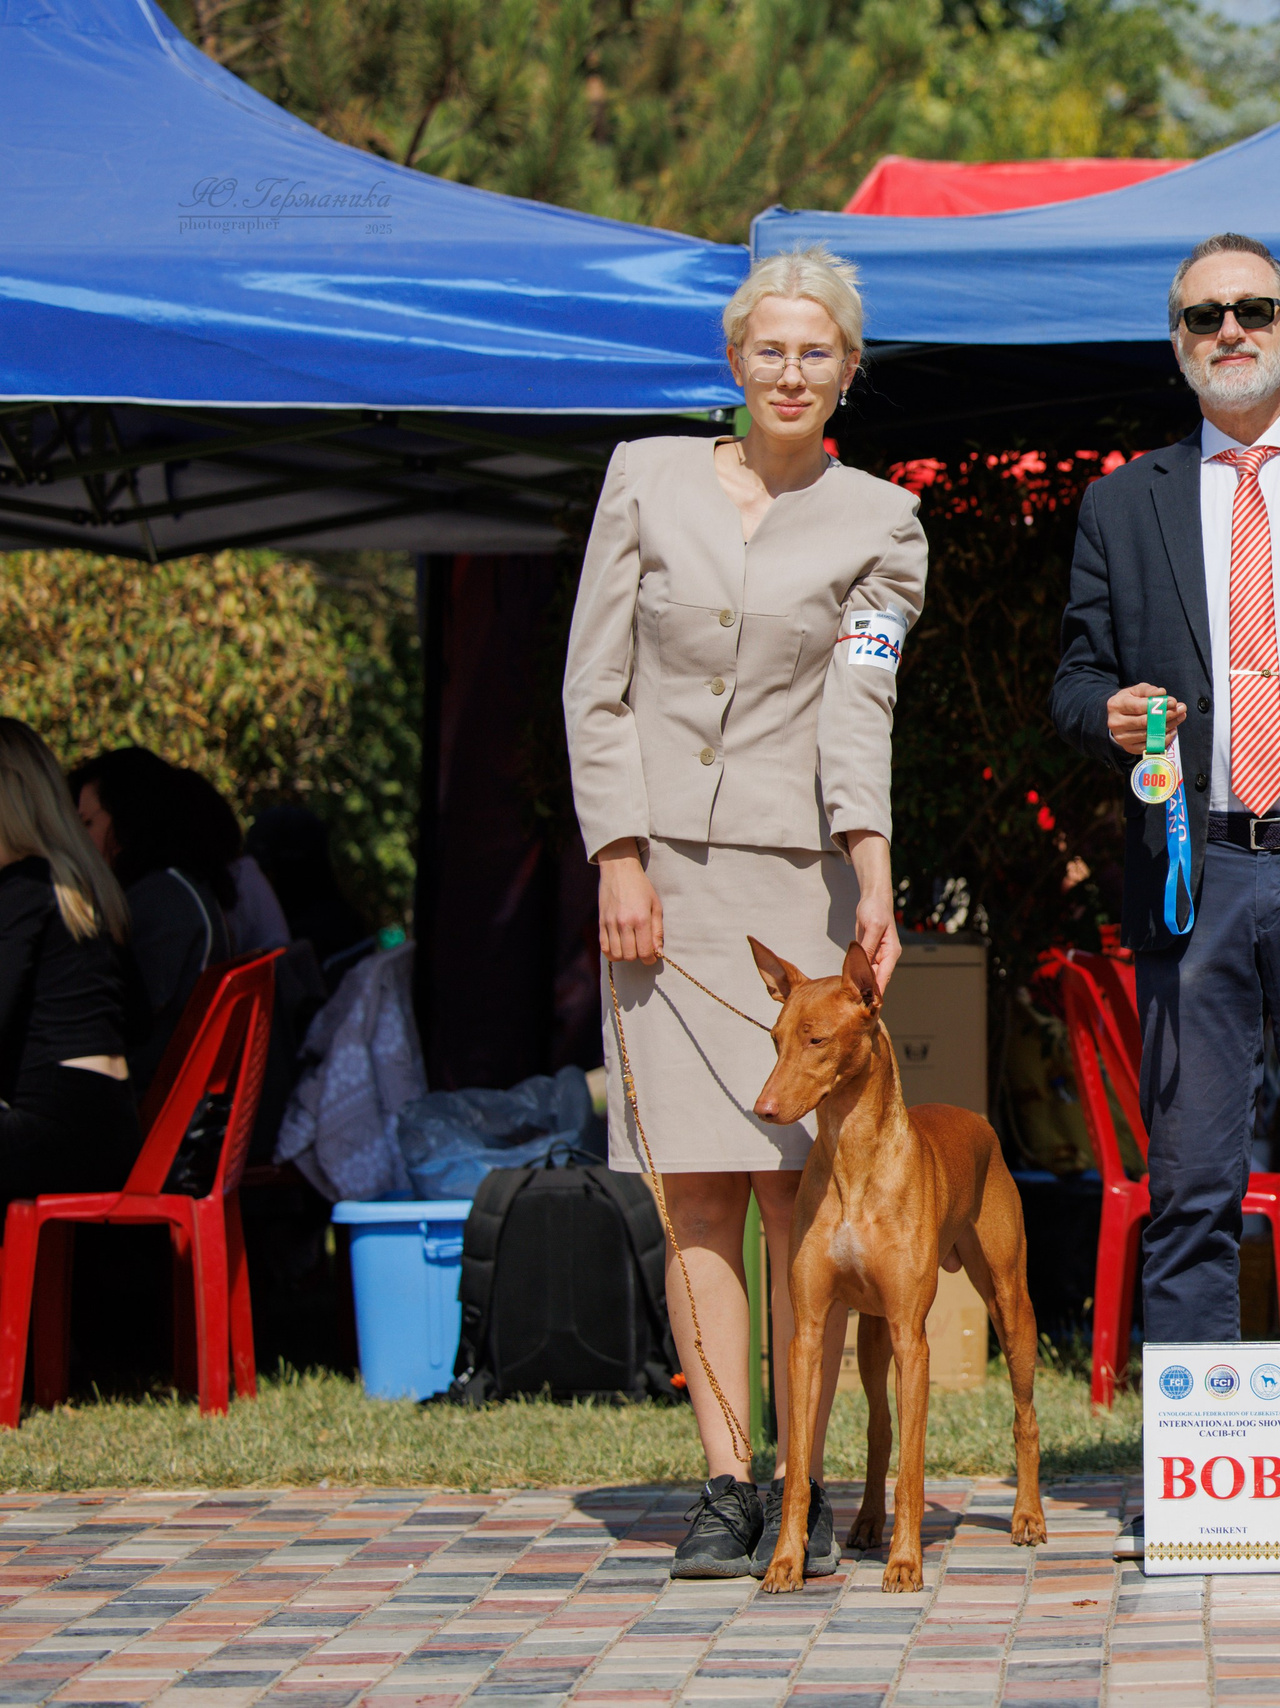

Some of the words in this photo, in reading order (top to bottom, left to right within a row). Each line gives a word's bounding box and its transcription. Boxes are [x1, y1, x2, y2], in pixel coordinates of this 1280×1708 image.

[855, 631, 900, 664] 224
[1143, 773, 1166, 787] BOB
[1169, 1379, 1183, 1387] FCI
[1213, 1379, 1231, 1387] FCI
[1159, 1420, 1234, 1428] INTERNATIONAL
[1198, 1526, 1248, 1534] TASHKENT
